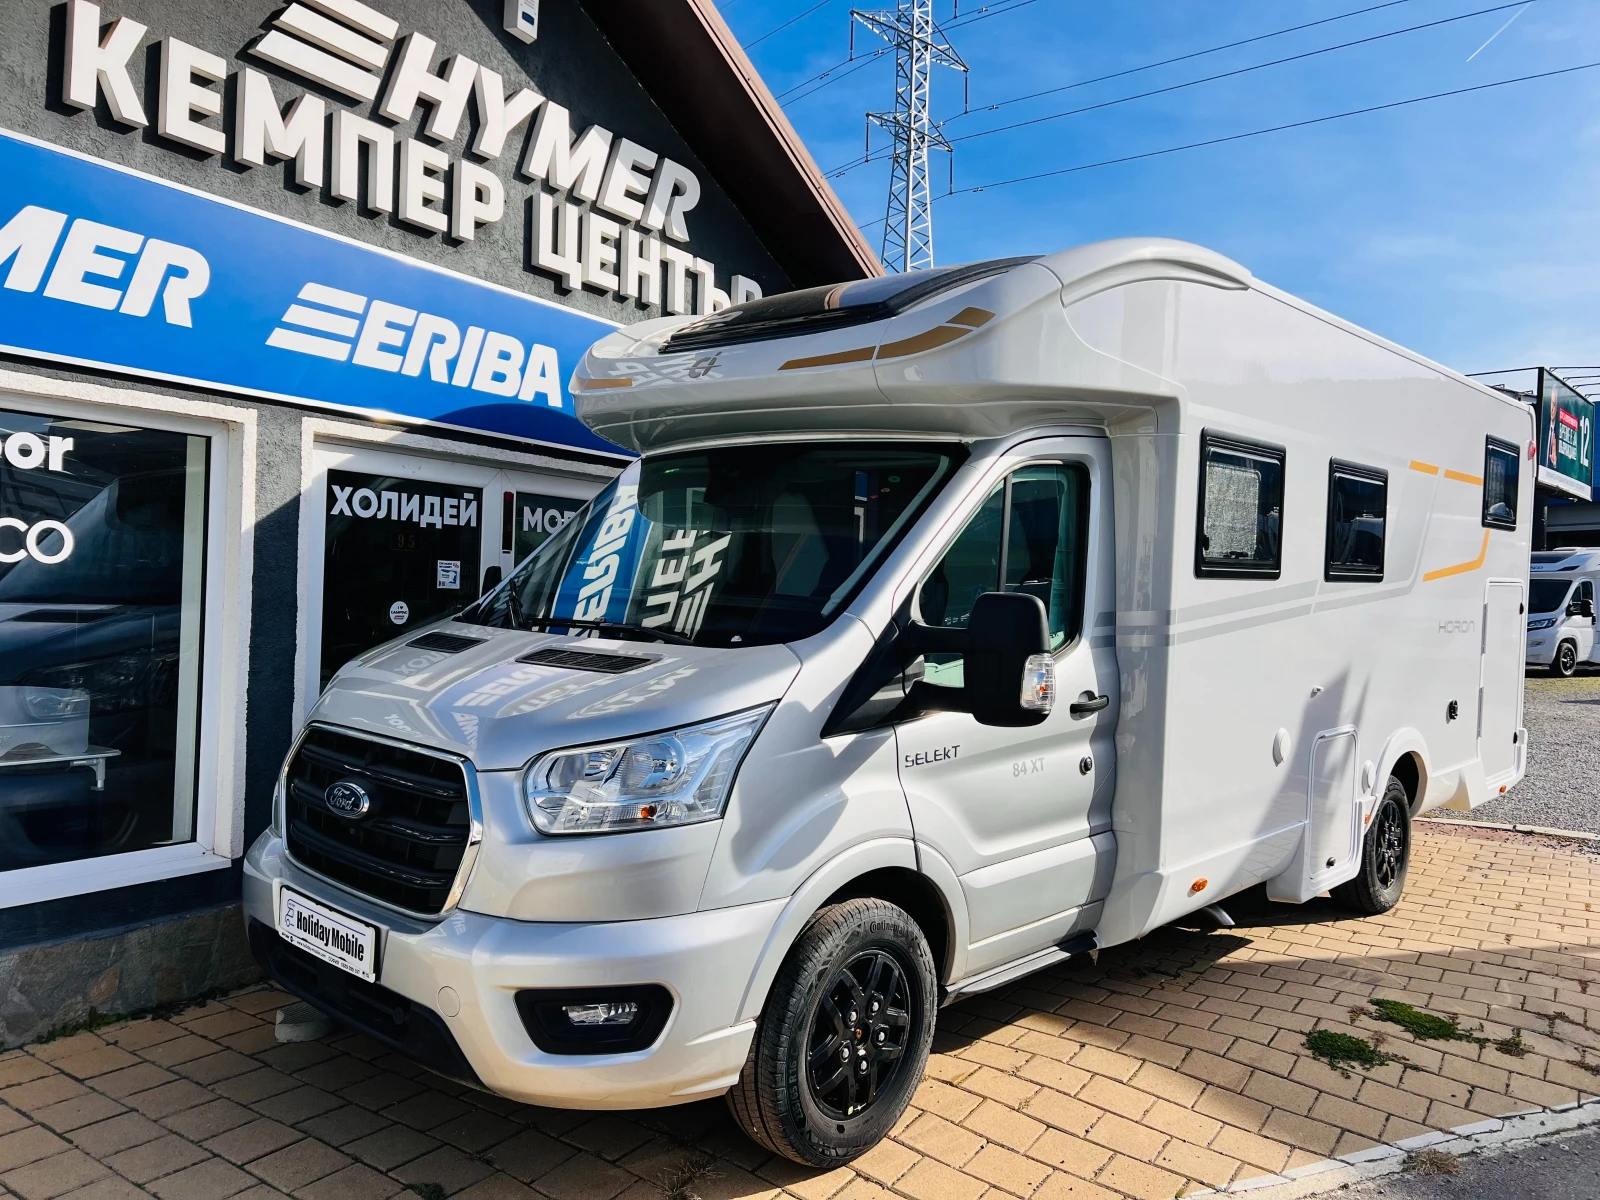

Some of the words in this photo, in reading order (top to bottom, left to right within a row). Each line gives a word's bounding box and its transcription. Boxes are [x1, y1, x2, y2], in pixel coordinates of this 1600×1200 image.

[62, 0, 504, 241] КЕМПЕР
[379, 31, 701, 242] HYMER
[352, 299, 563, 408] ERIBA
[0, 432, 74, 471] or
[1580, 415, 1590, 467] 12
[330, 484, 478, 529] ХОЛИДЕЙ
[1013, 763, 1028, 778] 84
[1031, 757, 1045, 773] XT
[330, 787, 355, 810] Ford
[296, 910, 331, 947] Holiday
[331, 927, 365, 962] Mobile
